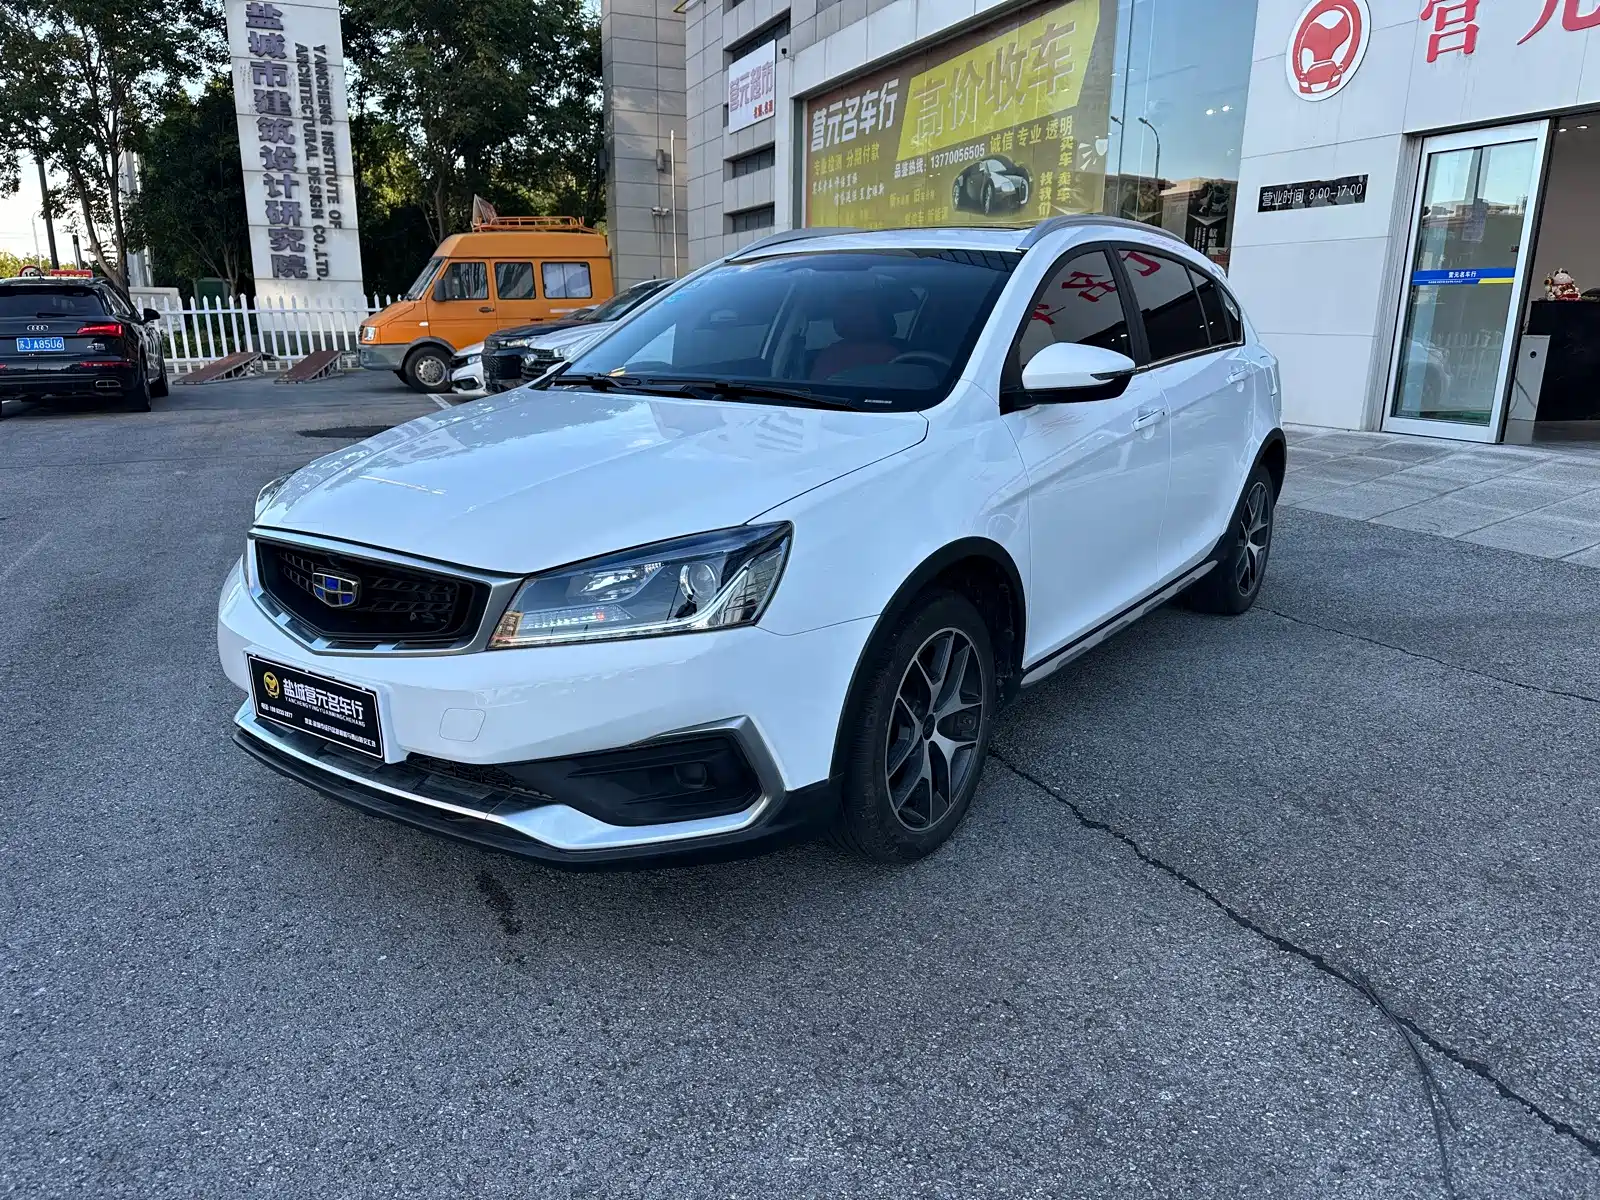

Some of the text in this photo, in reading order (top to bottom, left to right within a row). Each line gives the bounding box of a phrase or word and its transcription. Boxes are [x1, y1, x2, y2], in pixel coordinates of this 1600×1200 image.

[730, 61, 773, 112] 营元超市
[912, 20, 1077, 145] 高价收车
[246, 2, 308, 279] 盐城市建筑设计研究院
[295, 42, 317, 161] ARCHITECTURAL
[307, 166, 324, 219] DESIGN
[313, 44, 342, 229] YANCHENG INSTITUTE OF
[811, 78, 900, 152] 营元名车行
[990, 115, 1073, 153] 诚信 专业 透明
[931, 143, 985, 169] 13770056505
[1058, 136, 1074, 166] 买车
[1262, 188, 1304, 207] 营业时间
[283, 678, 364, 720] 盐城营元名车行
